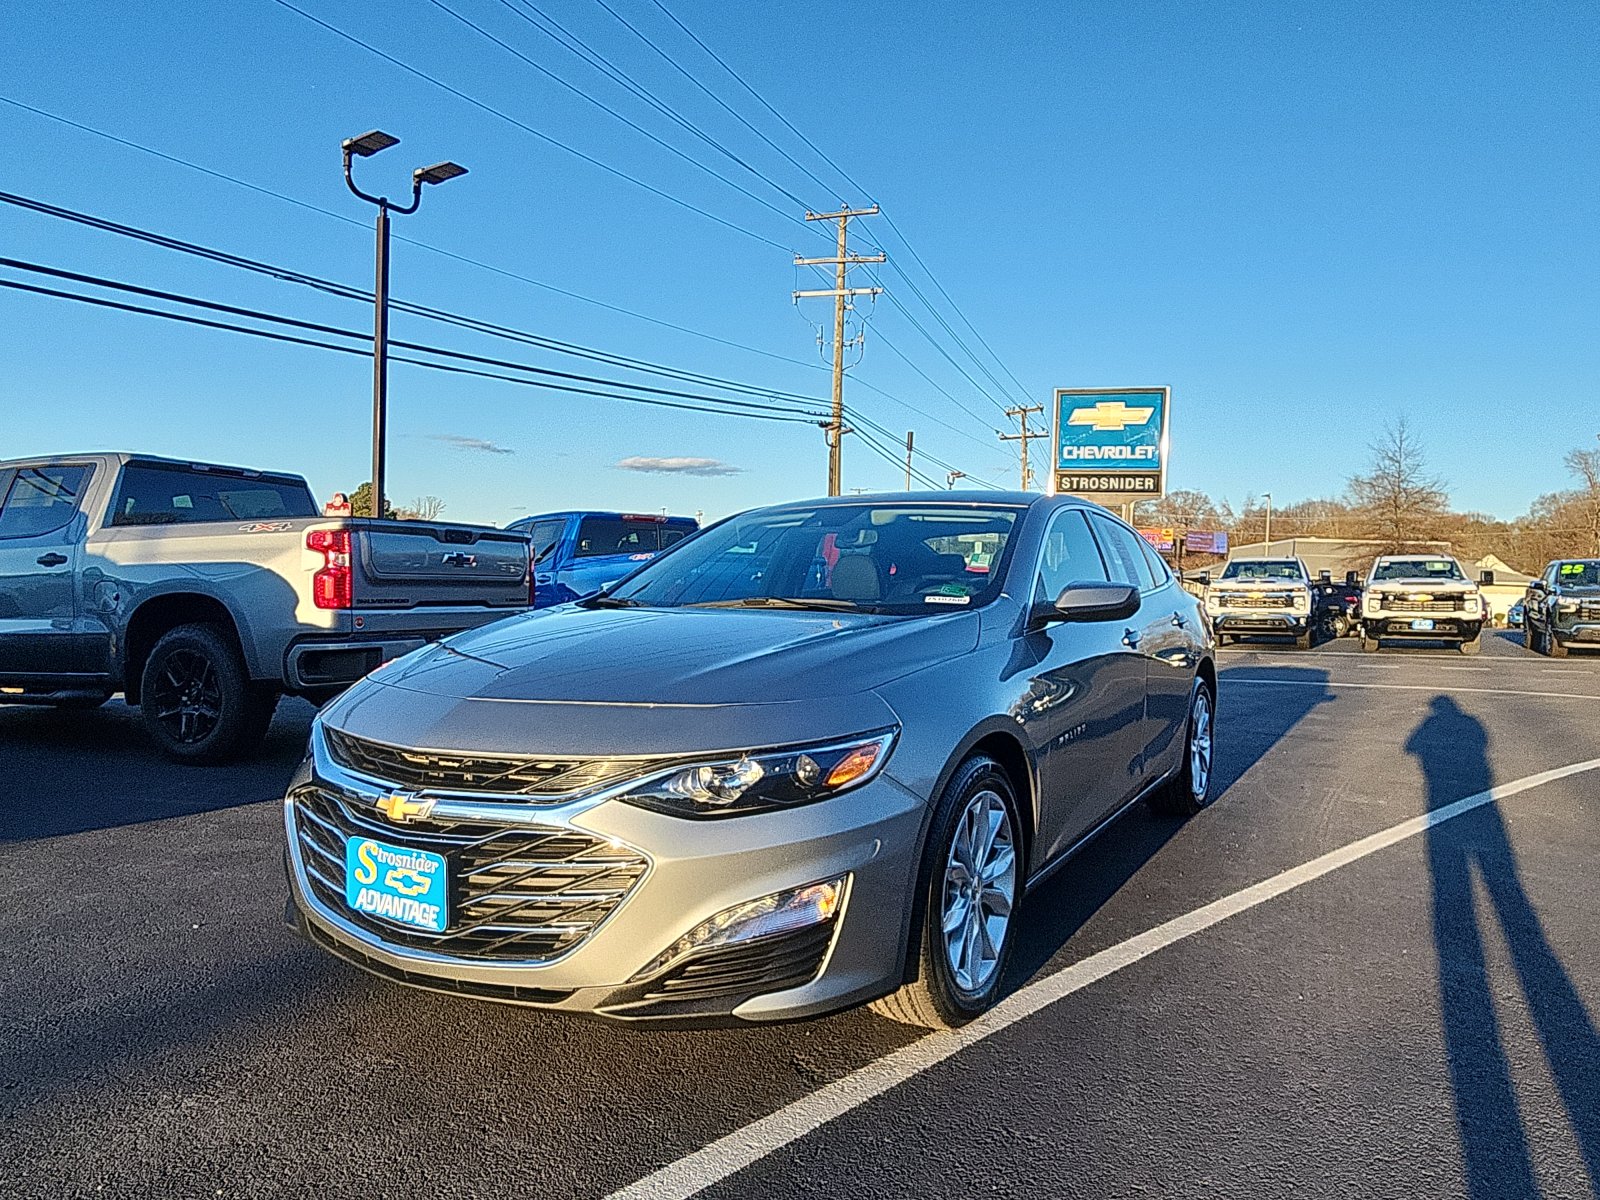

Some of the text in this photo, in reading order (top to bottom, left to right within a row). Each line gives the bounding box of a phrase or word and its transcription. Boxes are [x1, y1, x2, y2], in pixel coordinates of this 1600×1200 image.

[1063, 445, 1155, 459] CHEVROLET
[1061, 477, 1154, 489] STROSNIDER
[354, 841, 439, 884] Strosnider
[354, 888, 441, 928] ADVANTAGE
